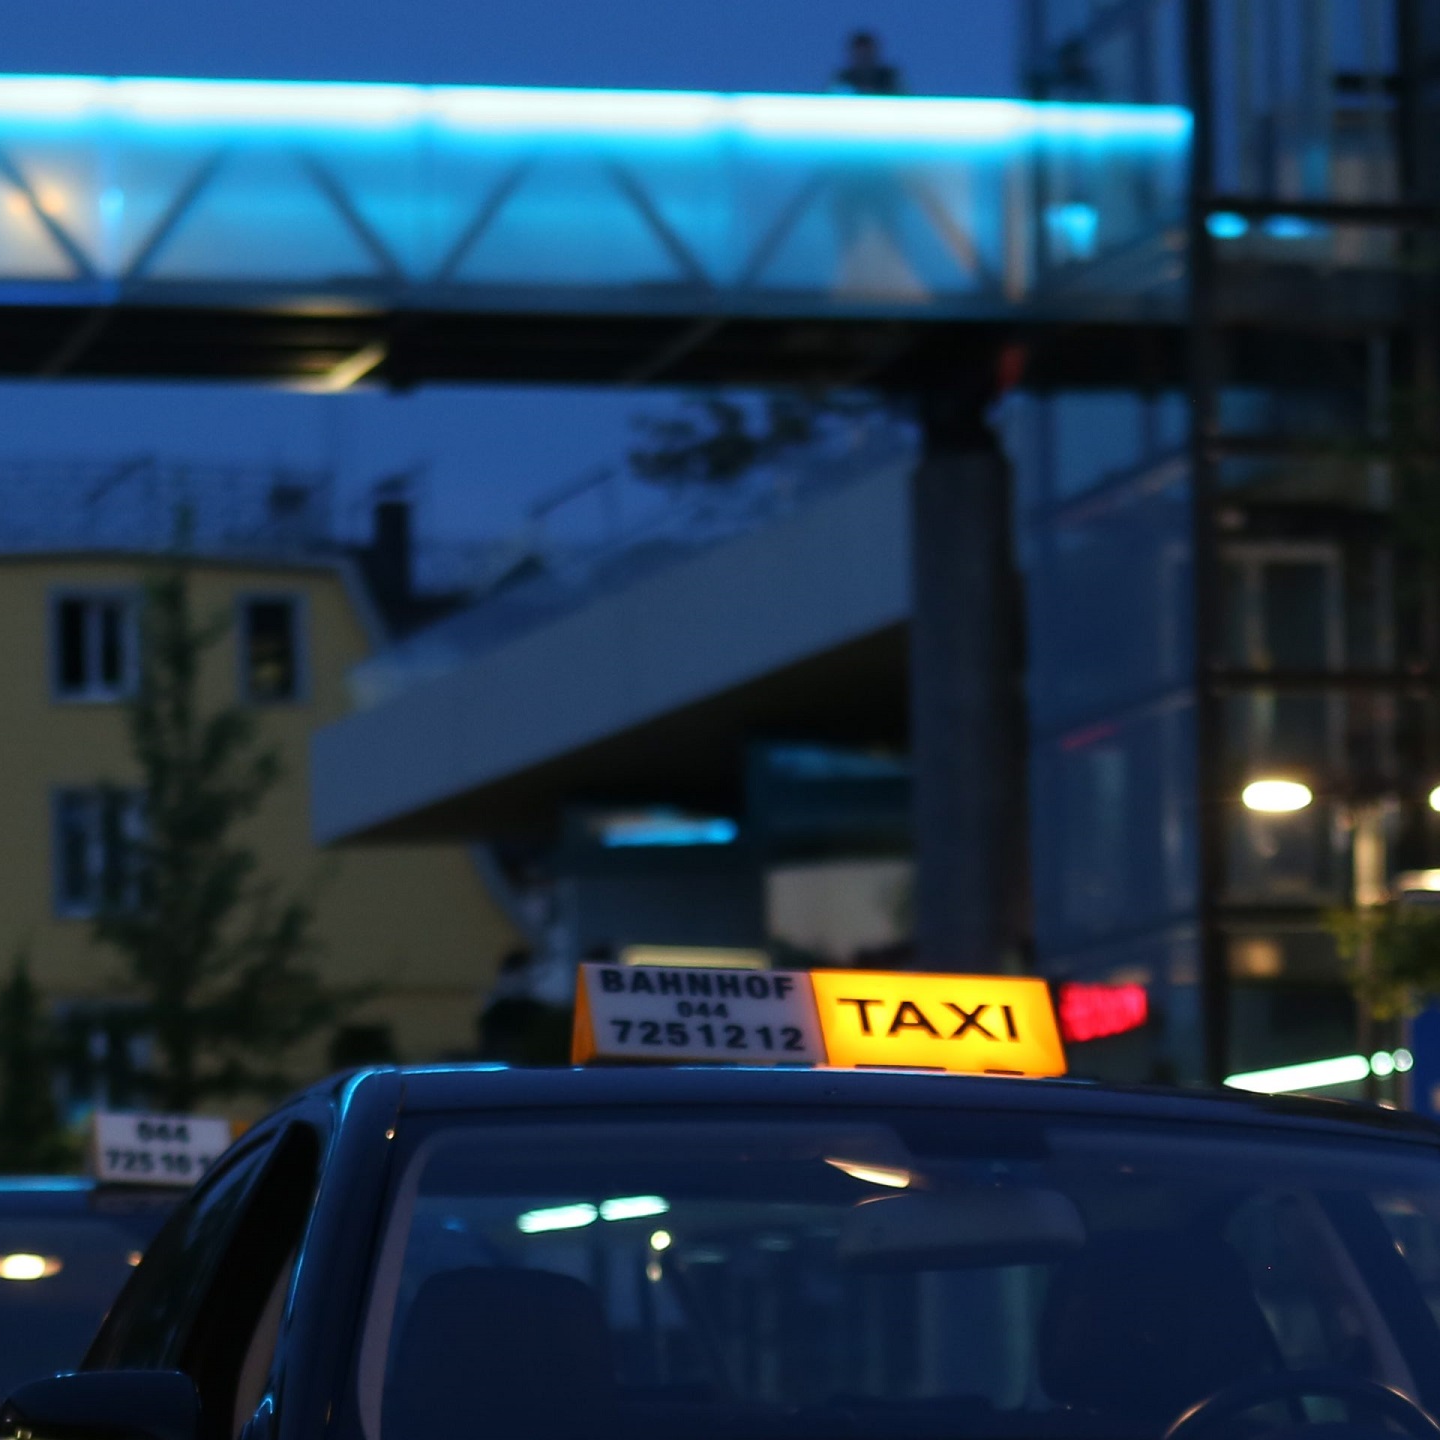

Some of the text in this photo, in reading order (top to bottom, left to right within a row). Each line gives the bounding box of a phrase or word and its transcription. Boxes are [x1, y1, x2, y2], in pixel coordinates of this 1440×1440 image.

[600, 969, 794, 1000] BAHNHOF
[676, 1001, 729, 1019] 044
[836, 998, 1022, 1042] TAXI
